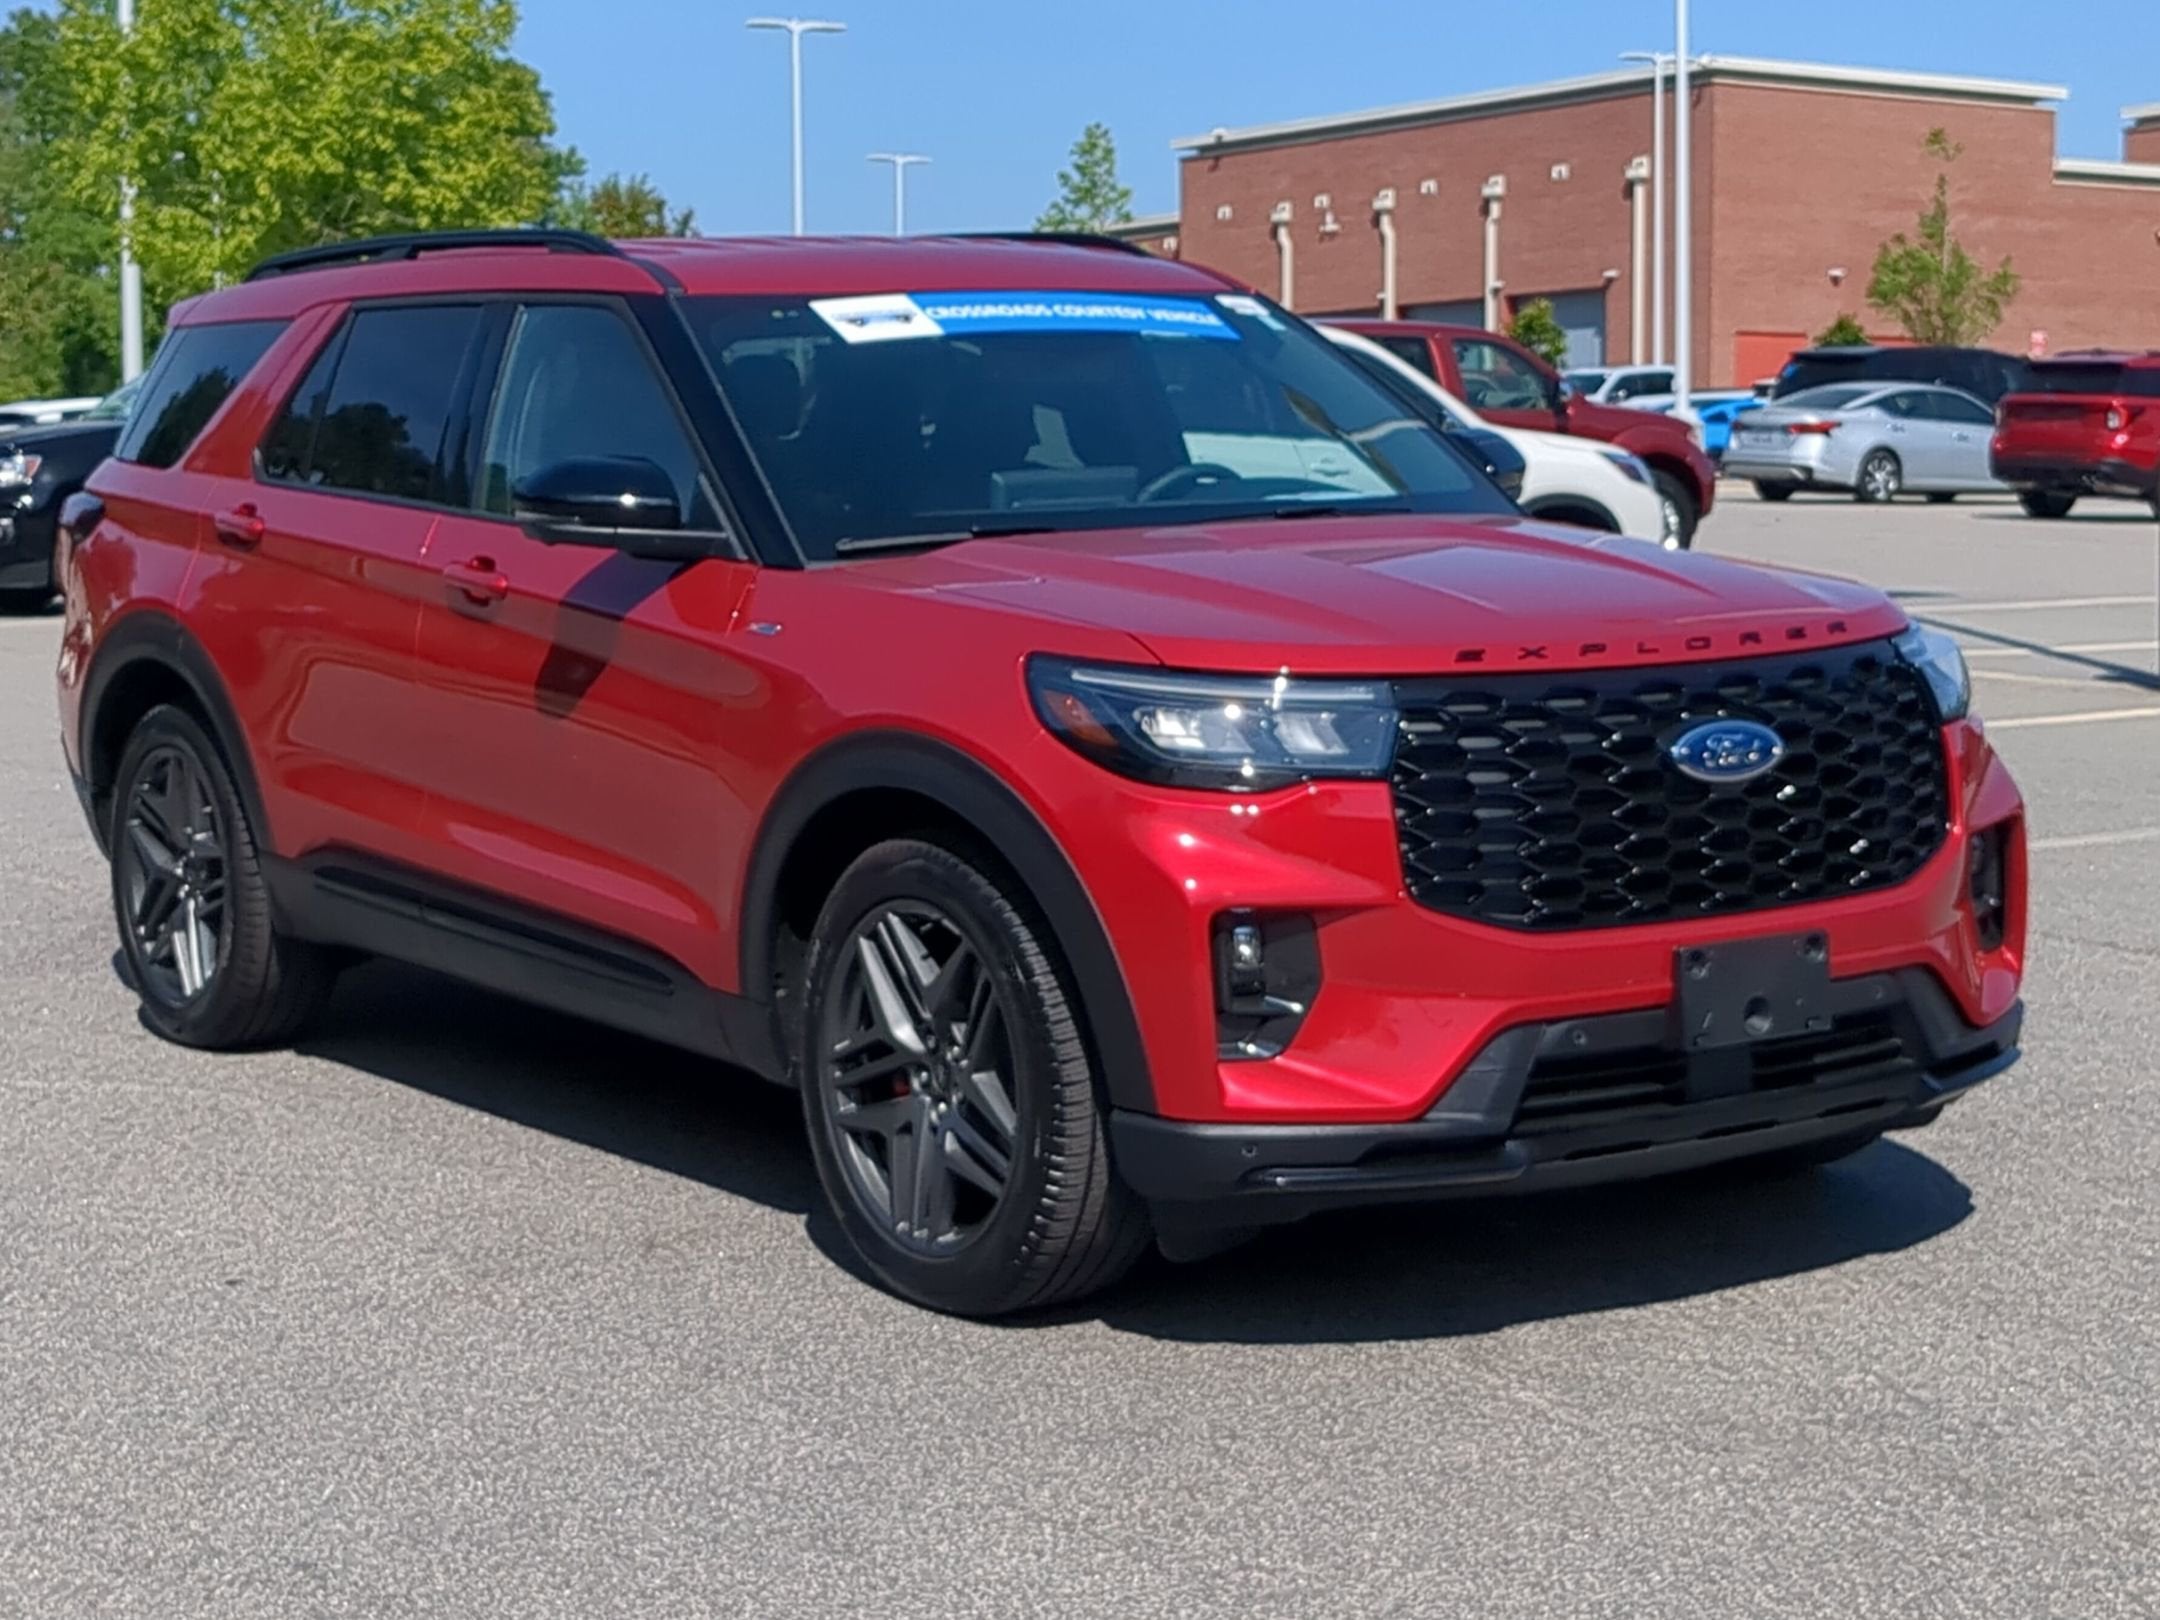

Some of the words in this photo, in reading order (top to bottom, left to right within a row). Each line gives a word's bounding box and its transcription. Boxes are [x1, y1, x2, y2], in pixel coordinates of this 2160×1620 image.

[925, 304, 1053, 320] CROSSROADS
[1053, 303, 1146, 320] COURTESY
[1146, 308, 1223, 327] VEHICLE
[1454, 620, 1848, 663] EXPLORER
